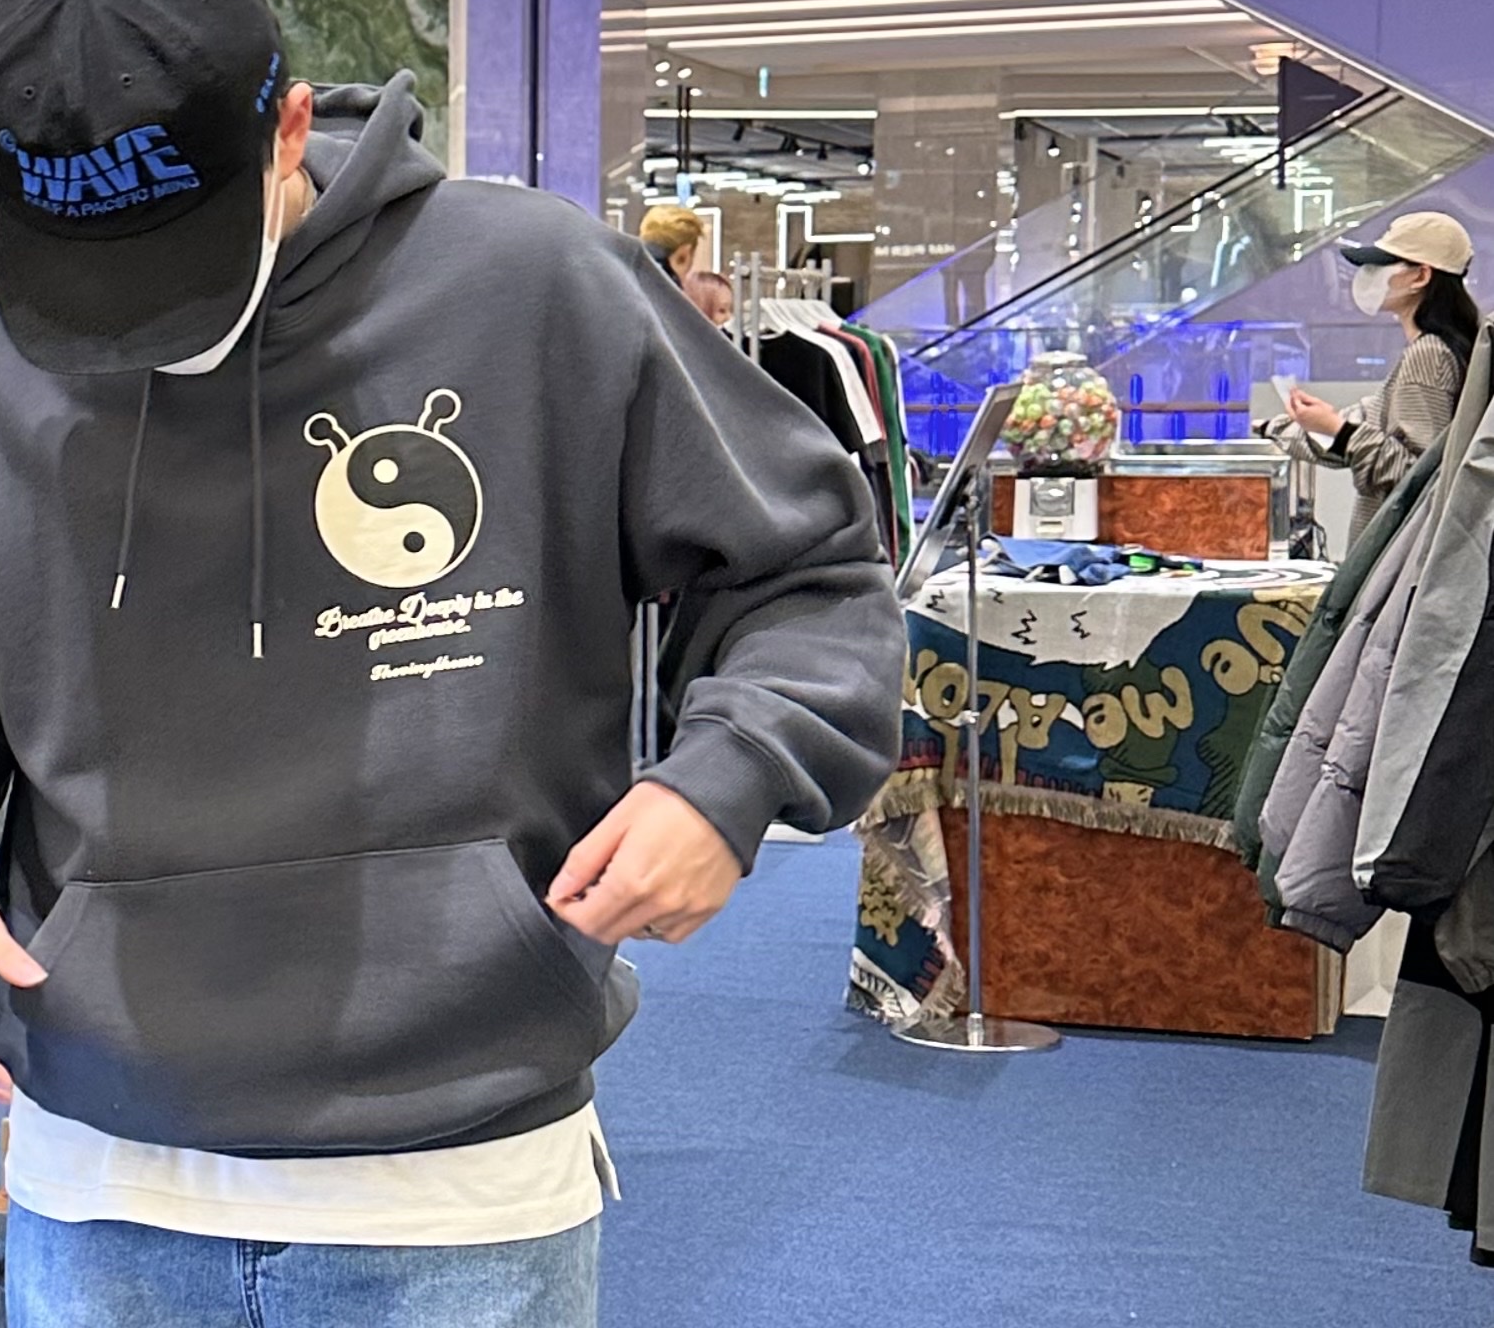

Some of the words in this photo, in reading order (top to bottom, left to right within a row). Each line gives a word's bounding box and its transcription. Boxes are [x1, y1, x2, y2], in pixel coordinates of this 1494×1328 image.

[16, 125, 195, 202] WAVE
[314, 605, 395, 638] Breathe
[396, 591, 474, 624] Deeply
[494, 587, 525, 608] the
